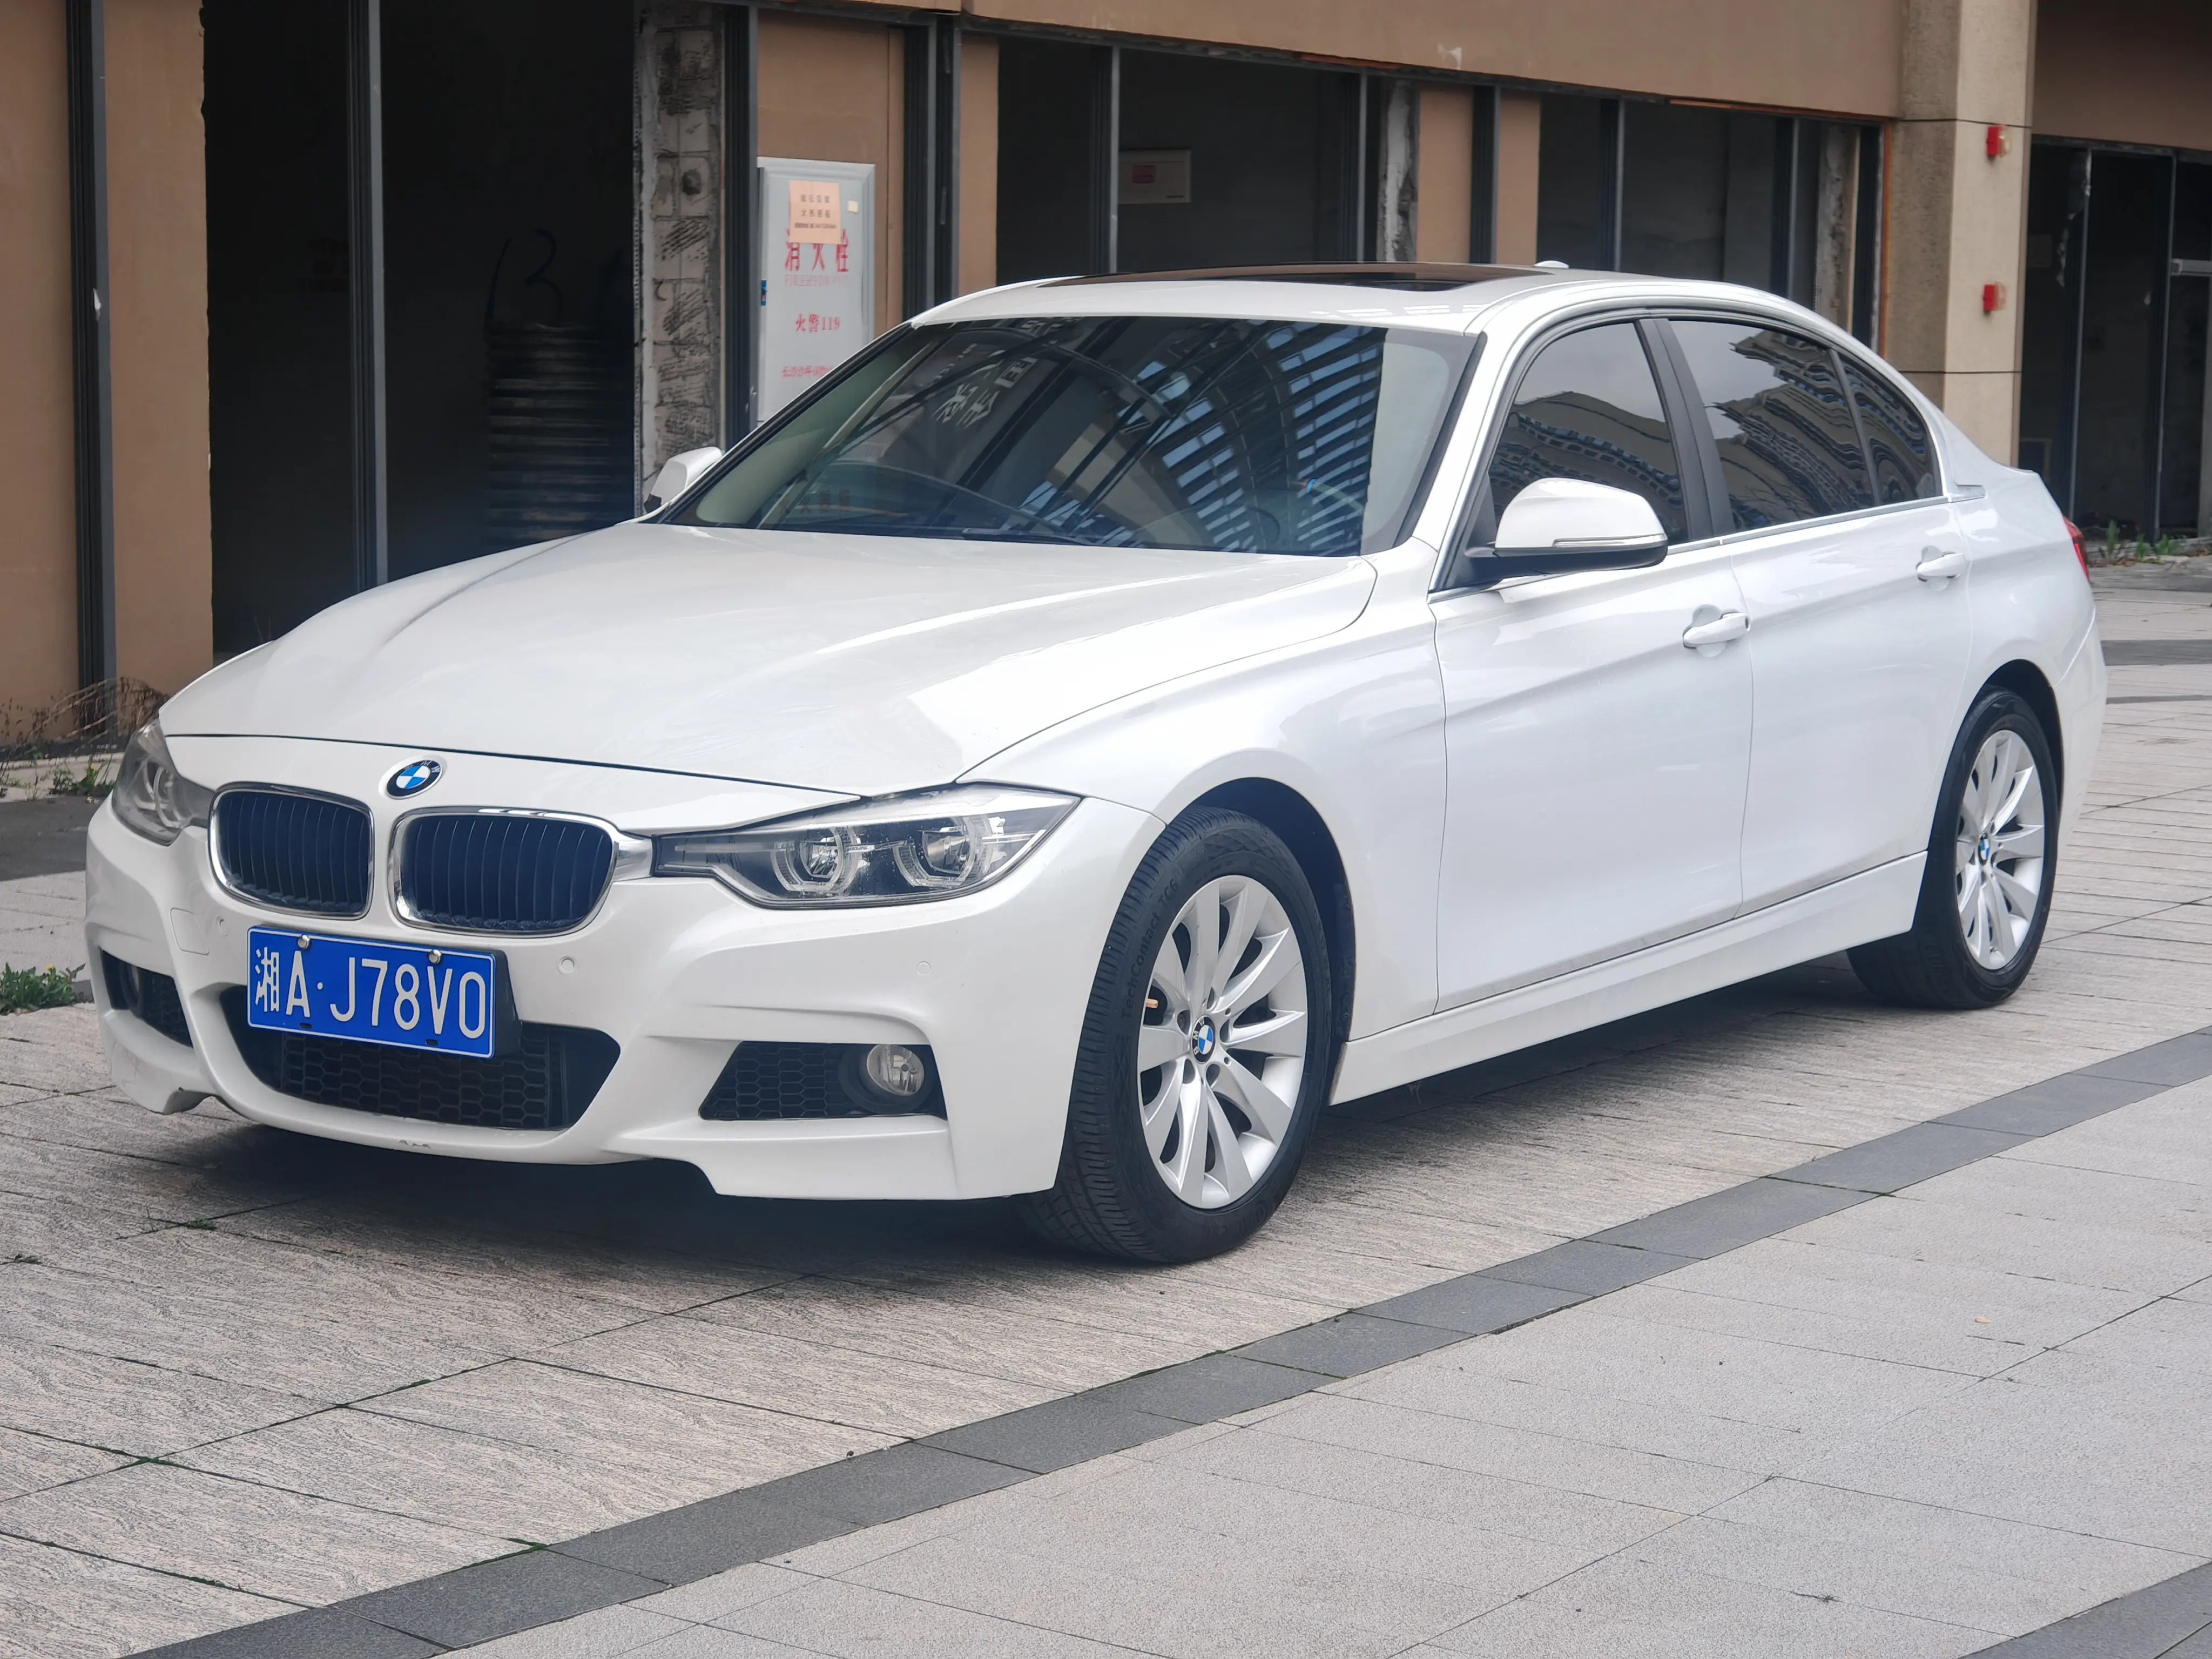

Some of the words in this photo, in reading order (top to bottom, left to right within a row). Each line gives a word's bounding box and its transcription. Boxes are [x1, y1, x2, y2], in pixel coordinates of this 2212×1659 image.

[795, 314, 840, 332] 火警119
[1121, 911, 1161, 1019] TechContact
[1158, 878, 1178, 908] TC6
[1193, 1017, 1205, 1055] BMW
